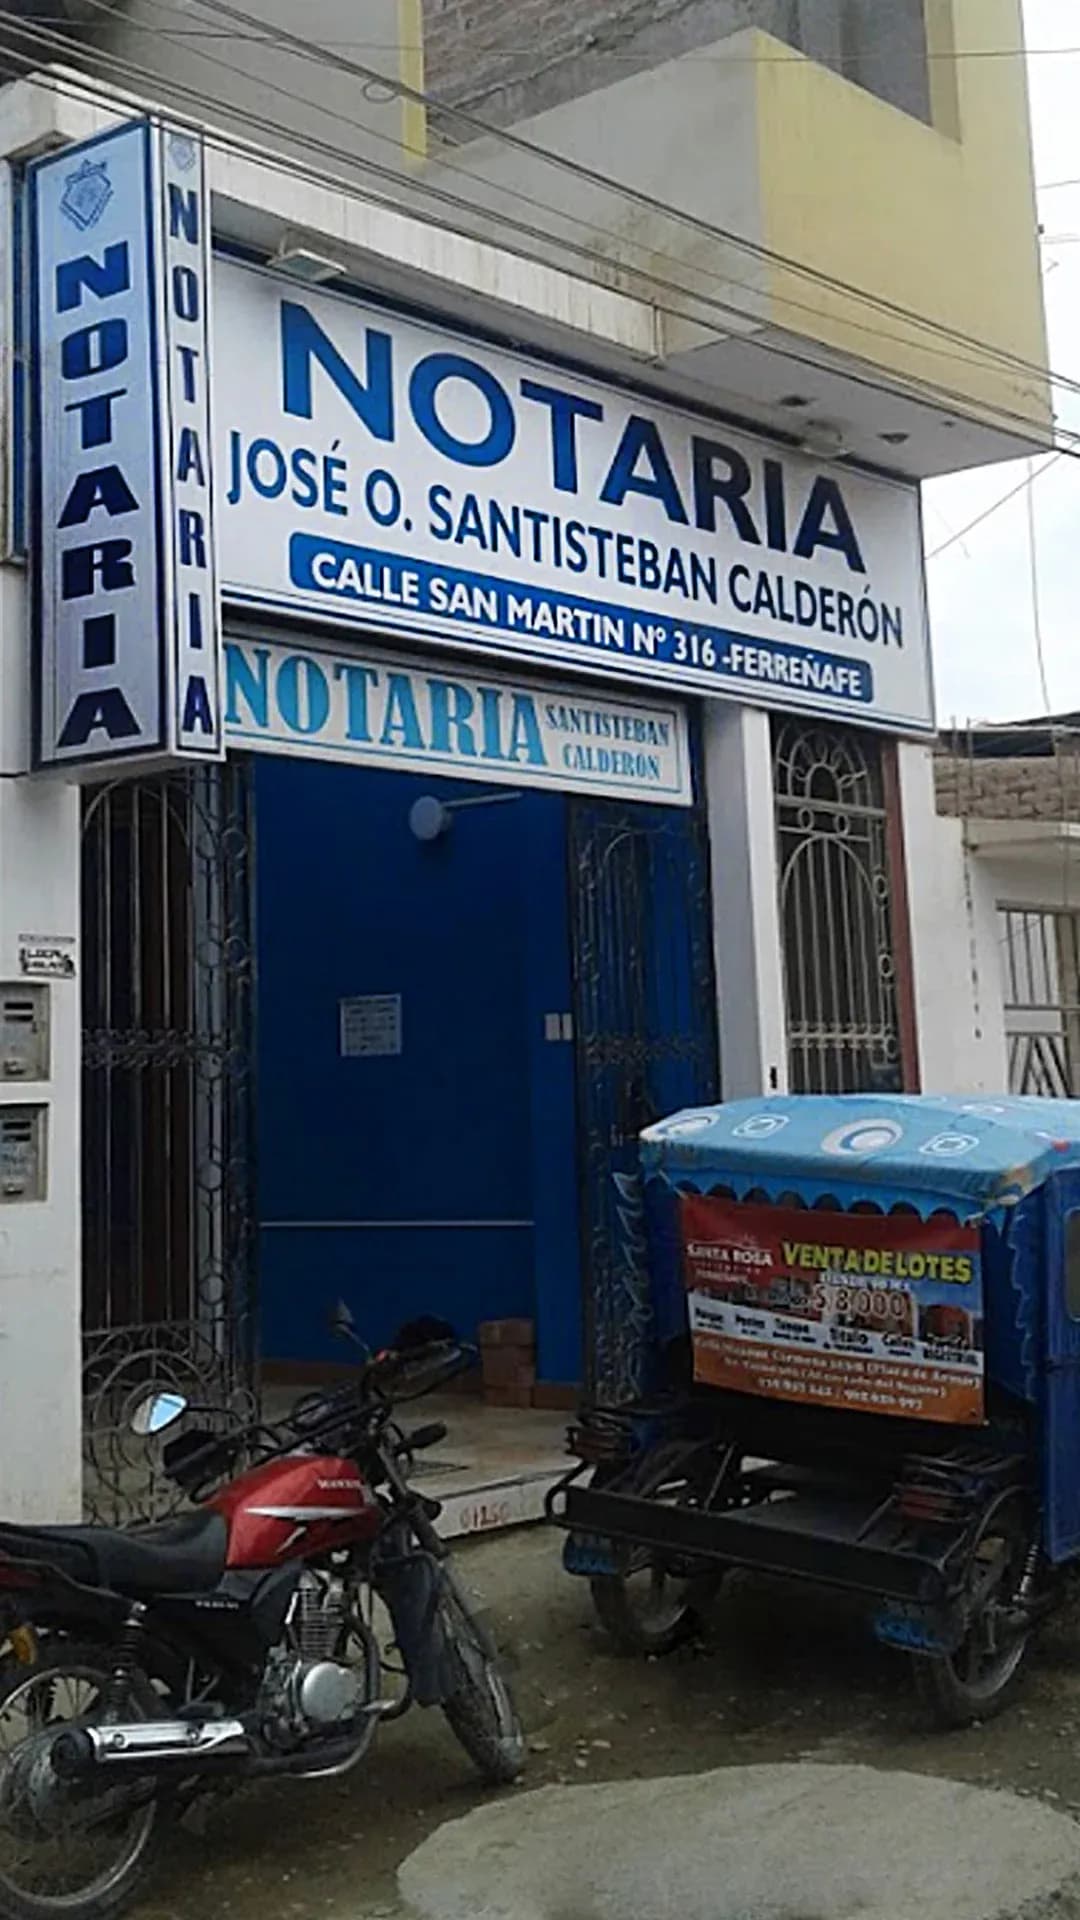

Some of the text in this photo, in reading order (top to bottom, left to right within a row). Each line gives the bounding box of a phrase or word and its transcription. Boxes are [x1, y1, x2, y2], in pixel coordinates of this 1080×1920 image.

[56, 240, 141, 749] NOTARIA
[169, 183, 213, 735] NOTARIA
[281, 299, 866, 573] NOTARIA
[226, 430, 904, 648] JOSÉ O. SANTISTEBAN CALDERÓN
[311, 553, 419, 606] CALLE
[428, 577, 498, 623] SAN
[506, 594, 625, 648] MARTIN
[674, 632, 716, 668] 316
[222, 643, 548, 767] NOTARIA
[544, 703, 670, 747] SANTISTEBAN
[562, 742, 661, 780] CALDERON
[783, 1241, 859, 1272] VENTA
[896, 1251, 972, 1284] LOTES
